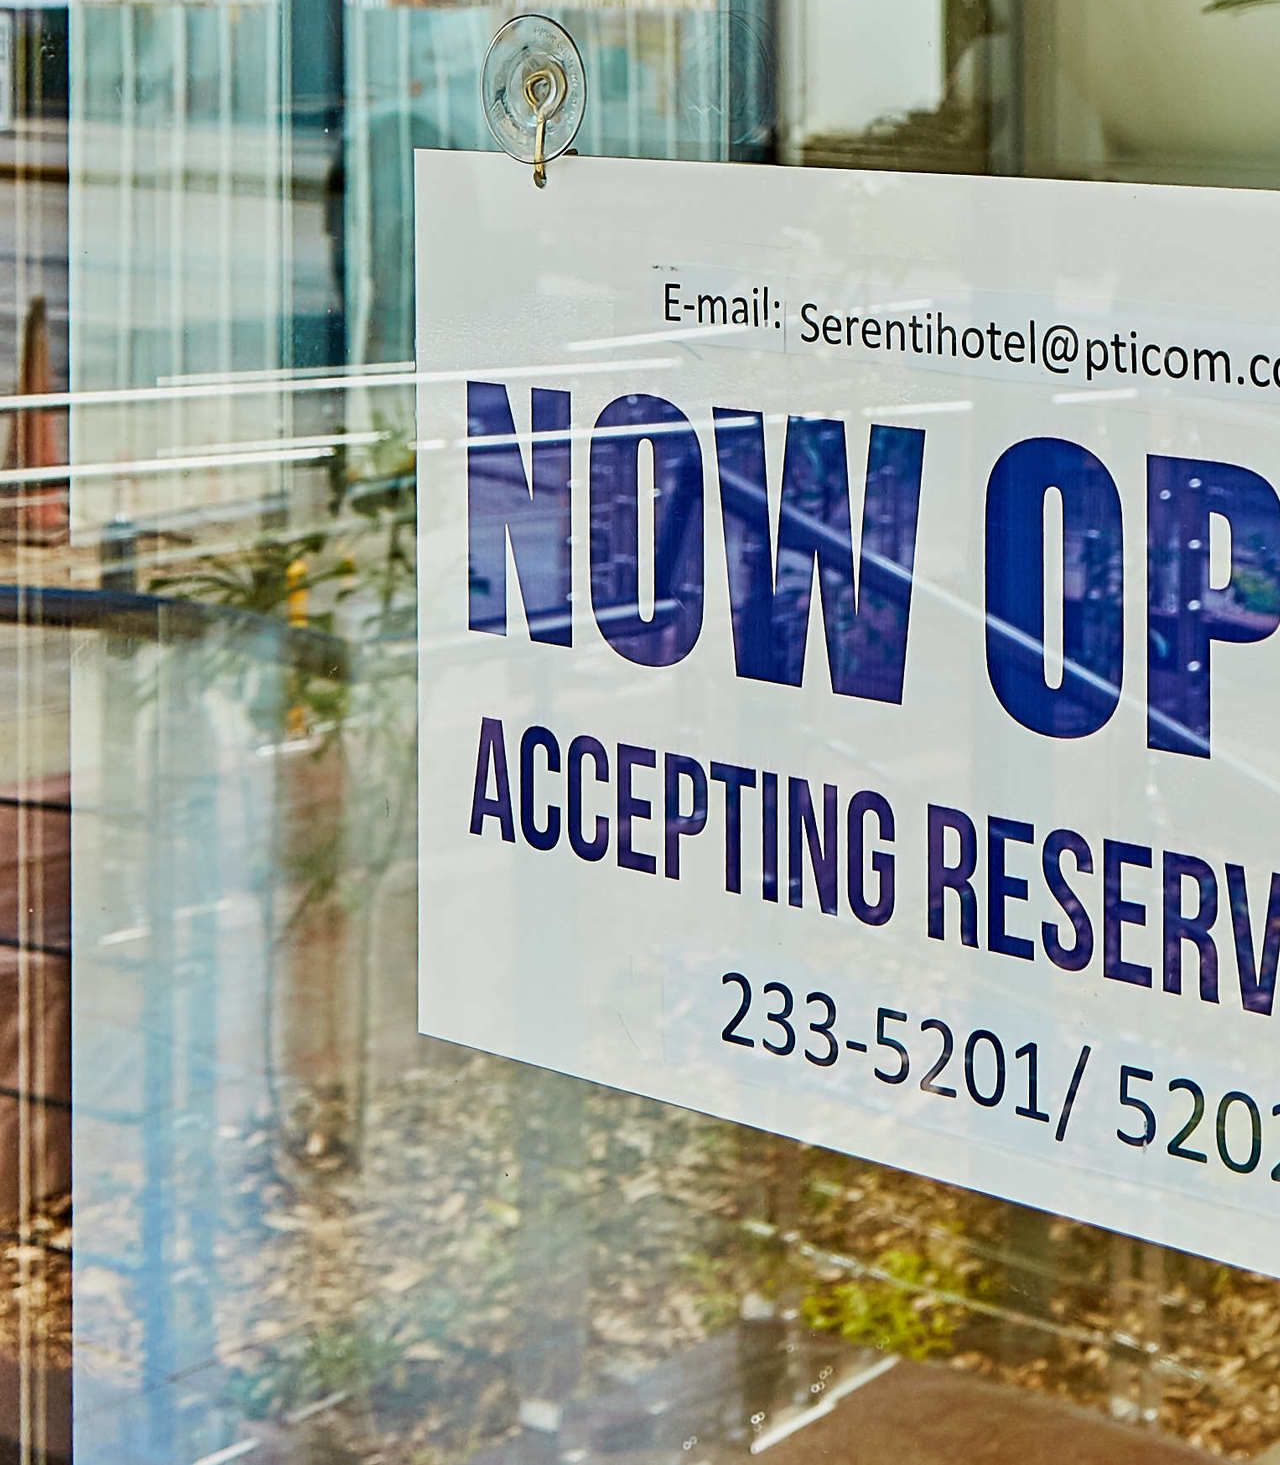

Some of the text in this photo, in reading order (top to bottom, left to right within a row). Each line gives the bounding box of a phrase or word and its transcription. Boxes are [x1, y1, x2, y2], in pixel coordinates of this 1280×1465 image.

[663, 281, 782, 331] E-mail:
[466, 380, 927, 705] NOW
[468, 716, 897, 928] ACCEPTING
[720, 972, 1093, 1143] 233-5201/
